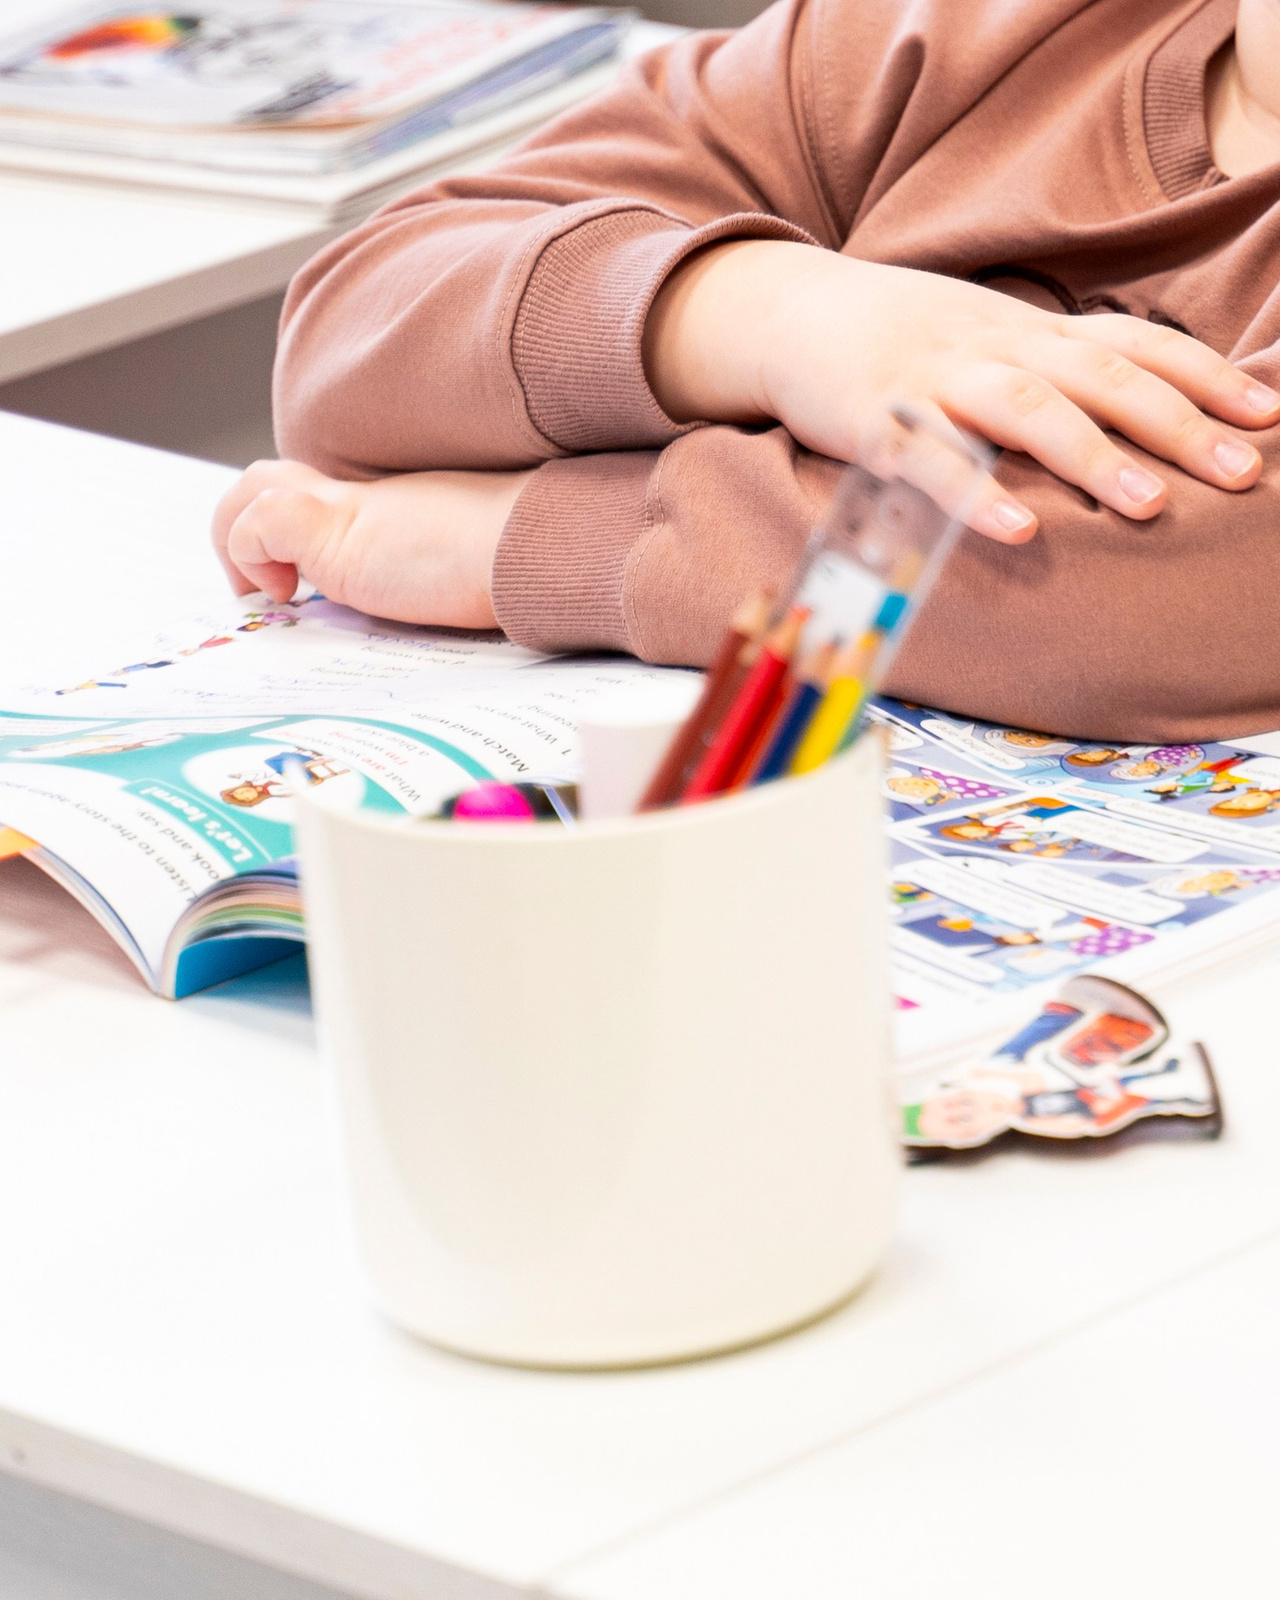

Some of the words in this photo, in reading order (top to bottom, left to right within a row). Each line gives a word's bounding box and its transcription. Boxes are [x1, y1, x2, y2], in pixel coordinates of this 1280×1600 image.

[448, 722, 484, 738] and
[520, 720, 558, 745] What
[361, 758, 387, 772] are
[384, 750, 409, 767] I'm
[482, 737, 530, 774] Match
[384, 771, 421, 802] What
[74, 802, 113, 825] story
[138, 784, 208, 824] learn!
[111, 822, 139, 843] the
[161, 827, 193, 852] and
[204, 819, 254, 863] Let's
[137, 841, 157, 858] to
[190, 851, 221, 880] ook
